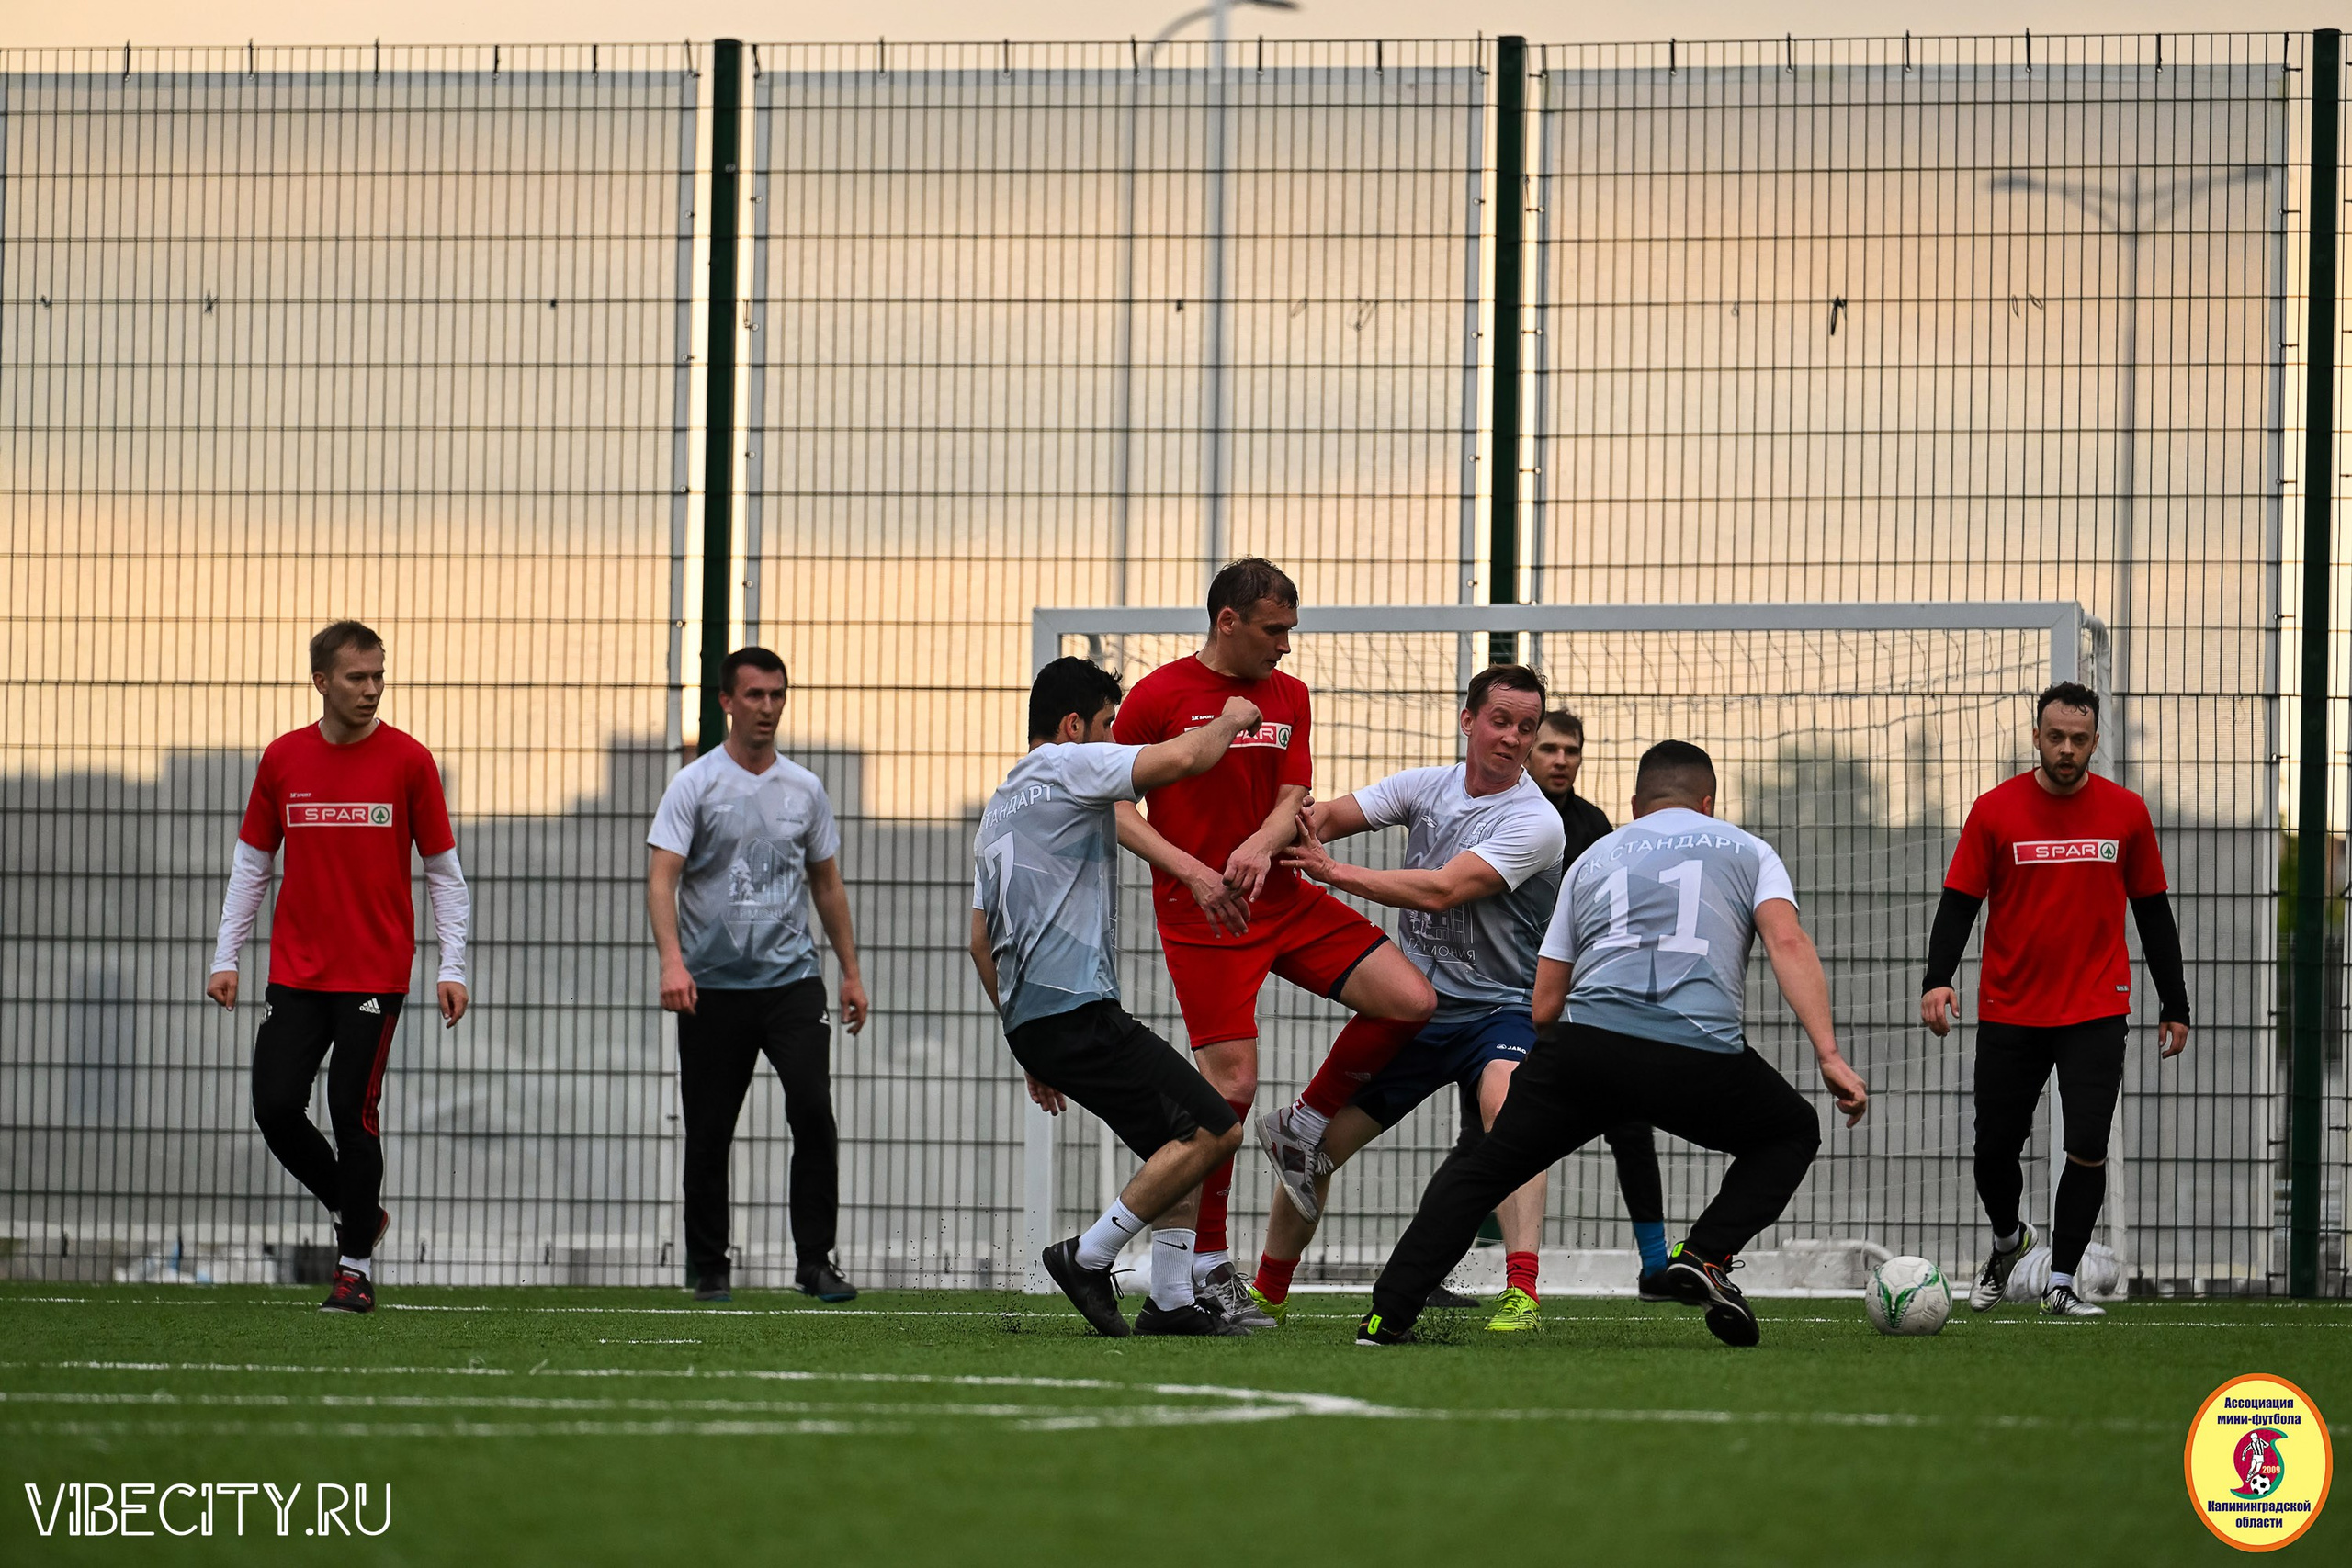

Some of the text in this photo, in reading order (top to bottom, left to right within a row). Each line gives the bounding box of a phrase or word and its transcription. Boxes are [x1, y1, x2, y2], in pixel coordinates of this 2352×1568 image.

[305, 808, 366, 820] SPAR
[982, 783, 1055, 829] ТАНДАРТ
[1577, 833, 1746, 883] СК СТАНДАРТ
[2035, 844, 2096, 858] SPAR
[984, 830, 1014, 937] 7
[1592, 860, 1710, 956] 11
[1508, 1045, 1527, 1054] JAKO
